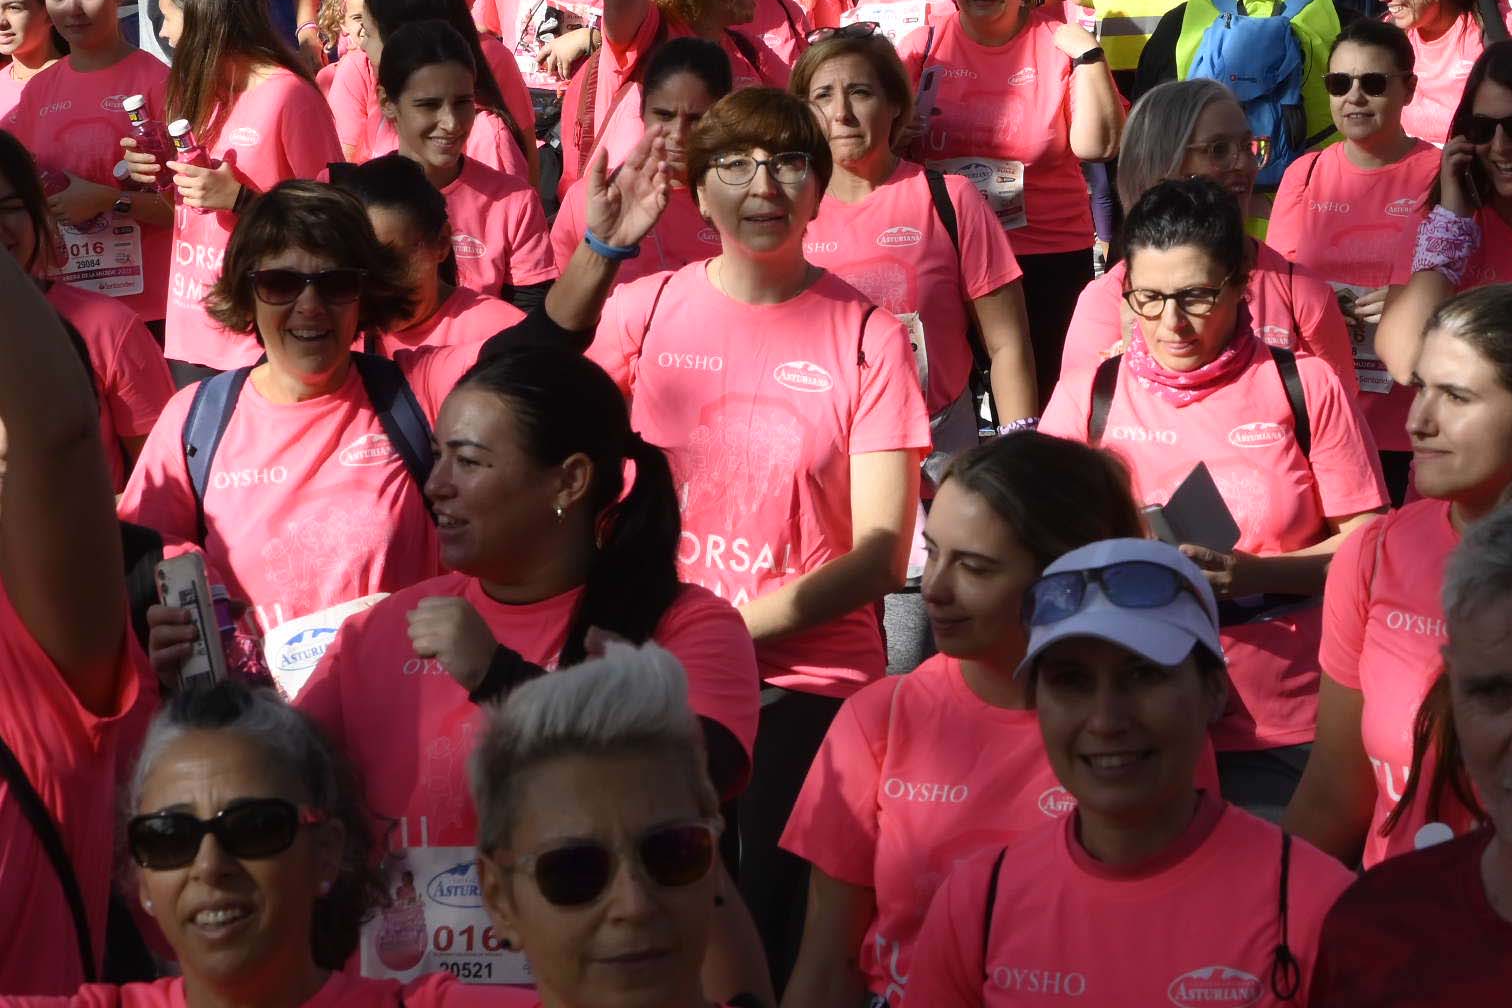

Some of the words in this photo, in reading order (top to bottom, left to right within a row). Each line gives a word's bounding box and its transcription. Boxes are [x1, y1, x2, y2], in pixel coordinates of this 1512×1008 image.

[70, 242, 104, 257] 016
[880, 235, 922, 245] ASTURIANA
[658, 351, 723, 373] OYSHO
[776, 368, 834, 390] ASTURIANA
[1360, 376, 1390, 384] Santand
[1112, 426, 1177, 445] OYSHO
[1232, 428, 1285, 445] ASTURIANA
[346, 445, 395, 462] ASTURIAN
[214, 465, 288, 490] OYSHO
[677, 530, 797, 575] ORSAL
[402, 658, 445, 675] OYS
[884, 776, 969, 805] OYSHO
[433, 925, 502, 952] 016
[992, 964, 1087, 999] OYSHO
